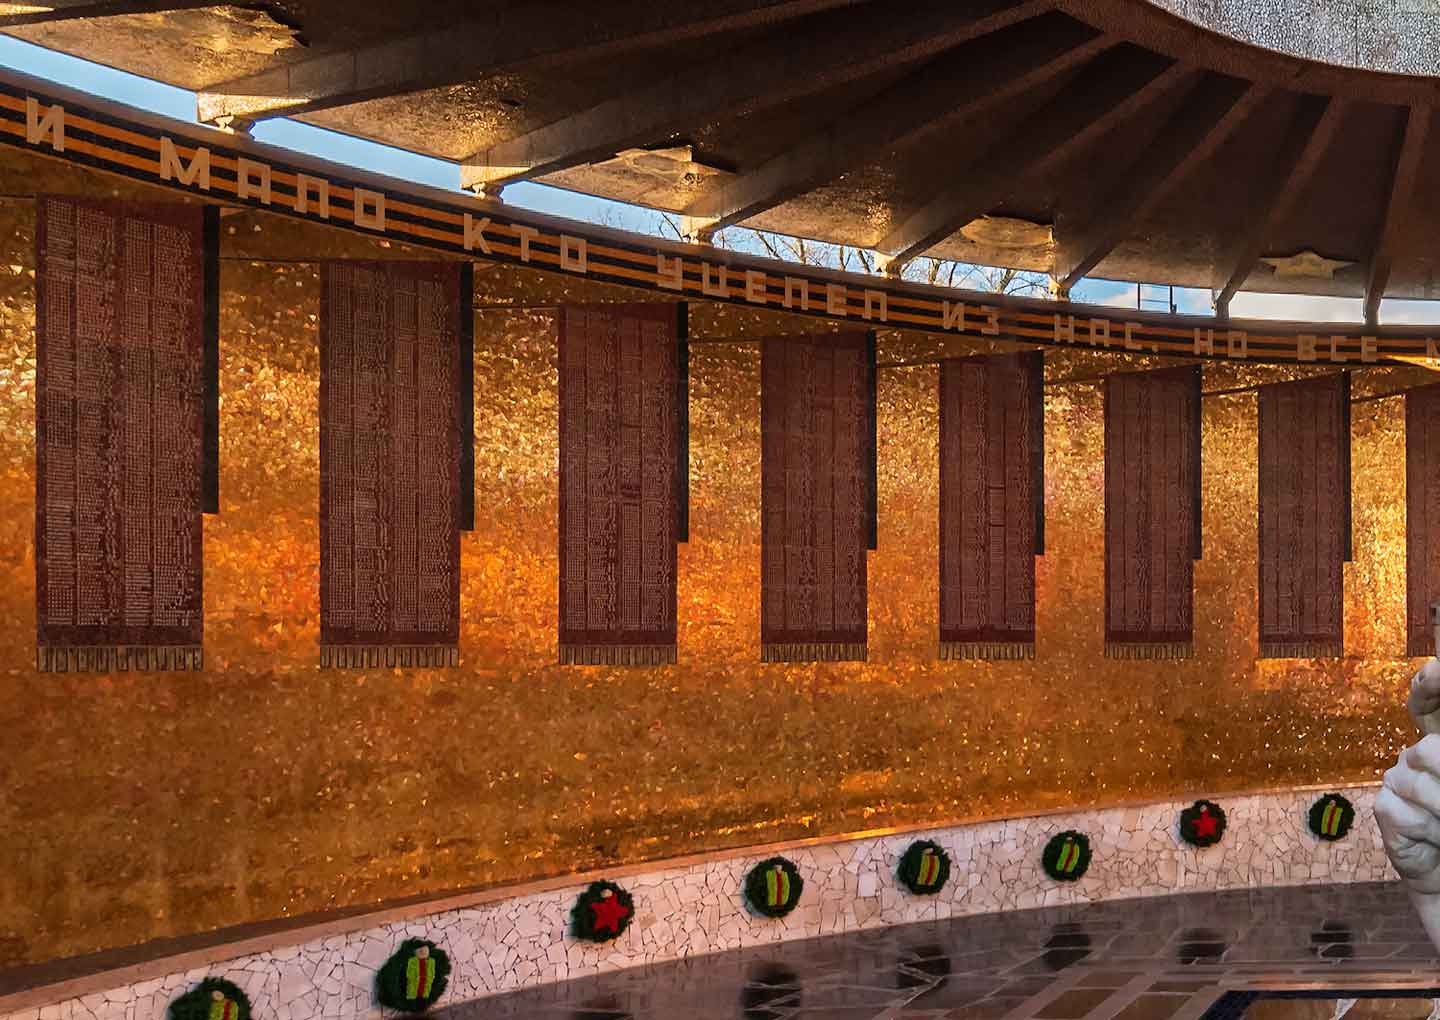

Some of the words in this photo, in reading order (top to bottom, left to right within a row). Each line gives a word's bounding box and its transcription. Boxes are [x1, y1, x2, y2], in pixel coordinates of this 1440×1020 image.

[26, 96, 65, 152] И
[463, 213, 587, 273] КТО
[942, 300, 1000, 336] ИЗ
[1054, 314, 1160, 353] НАС.
[1193, 327, 1248, 359] НО
[1297, 333, 1378, 363] ВСЕ
